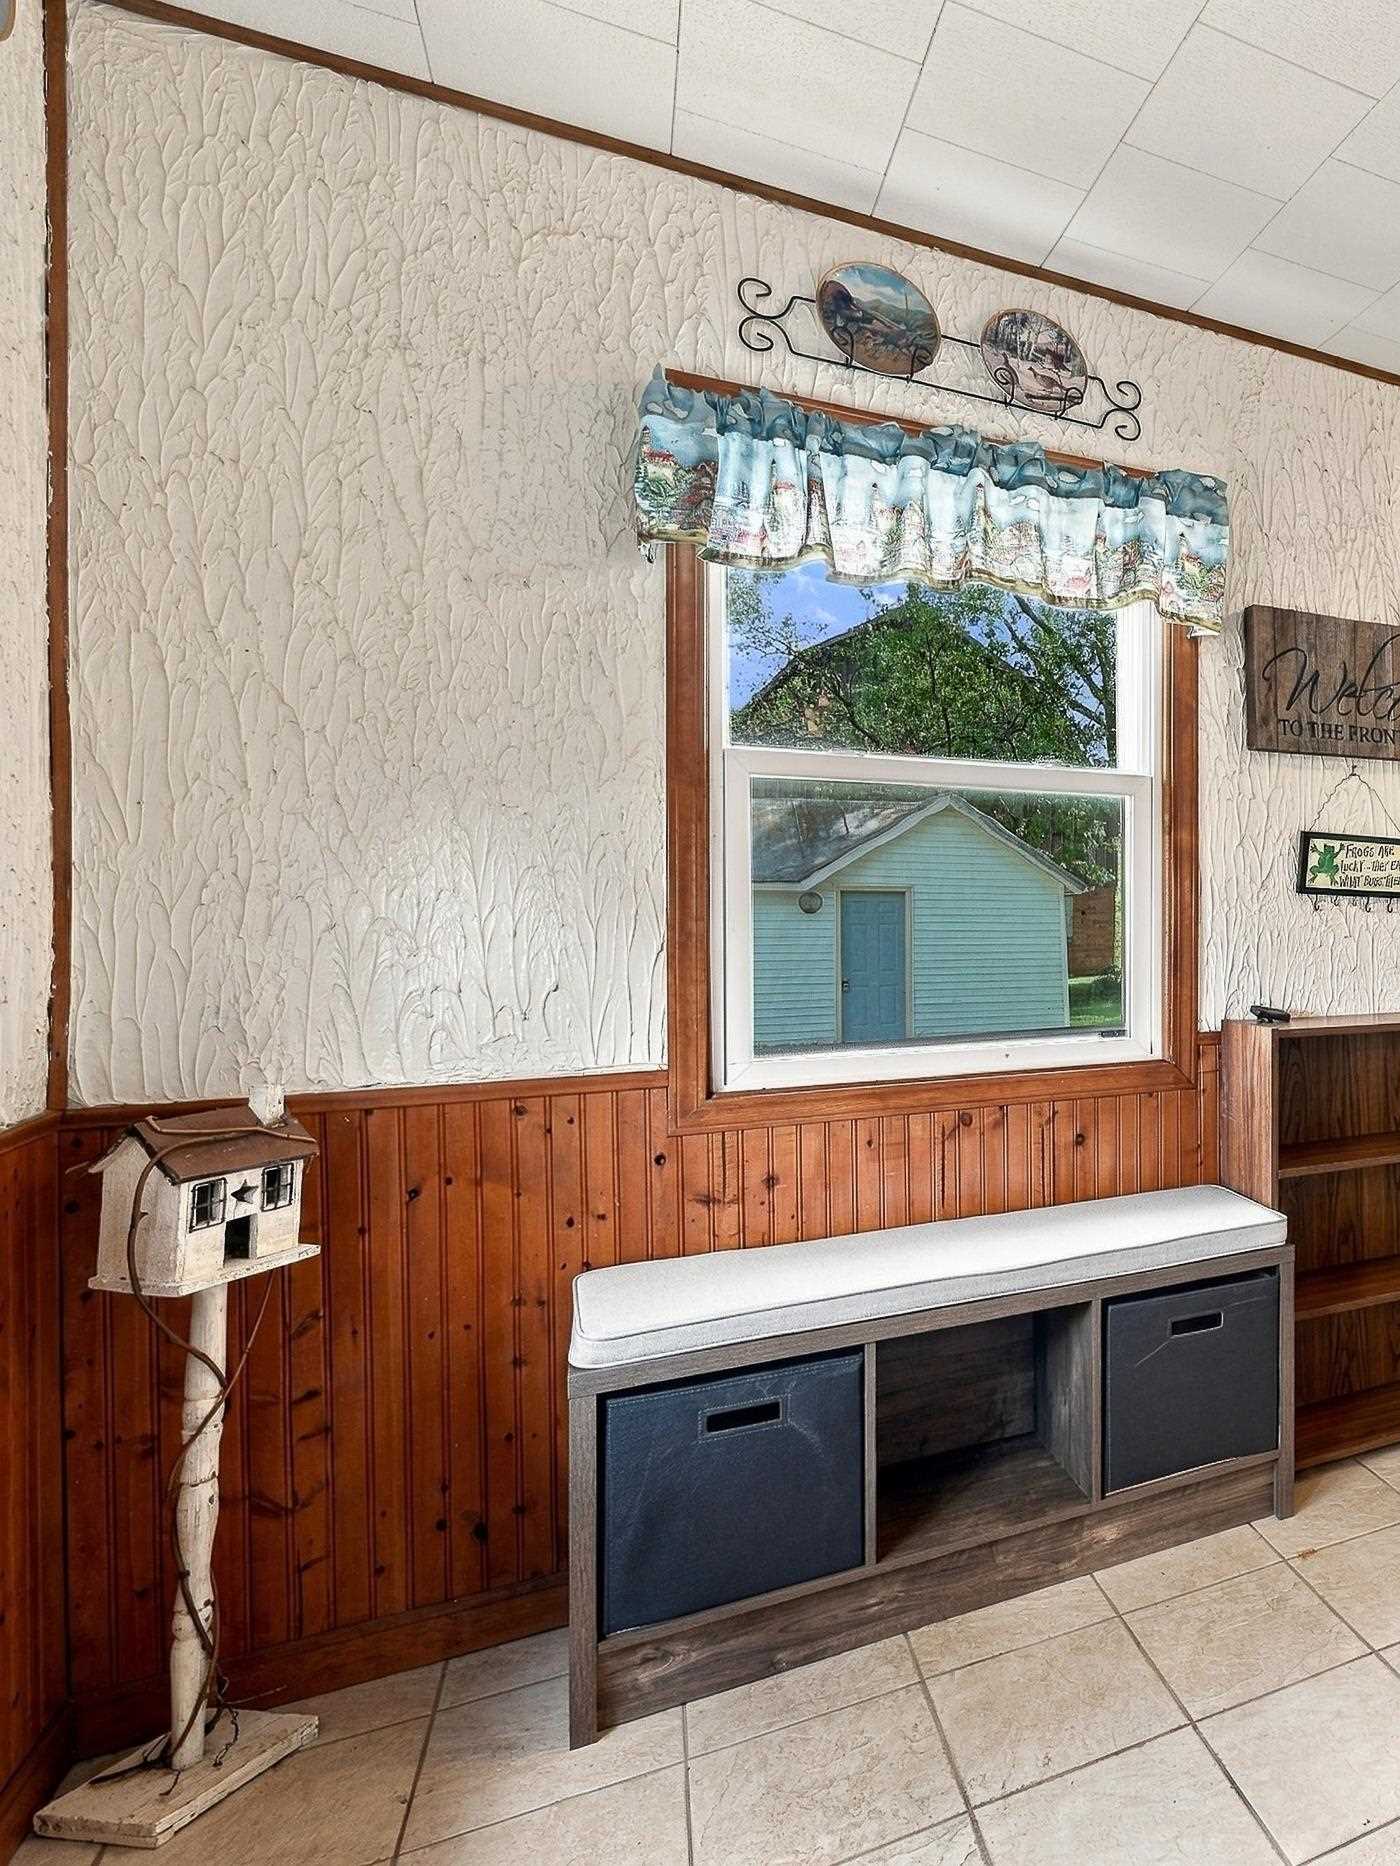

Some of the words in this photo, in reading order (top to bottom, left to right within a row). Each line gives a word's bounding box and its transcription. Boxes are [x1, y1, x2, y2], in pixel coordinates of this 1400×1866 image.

[1279, 718, 1304, 737] TO
[1306, 720, 1345, 742] THE
[1345, 843, 1375, 858] FROGS
[1377, 845, 1395, 859] ARE
